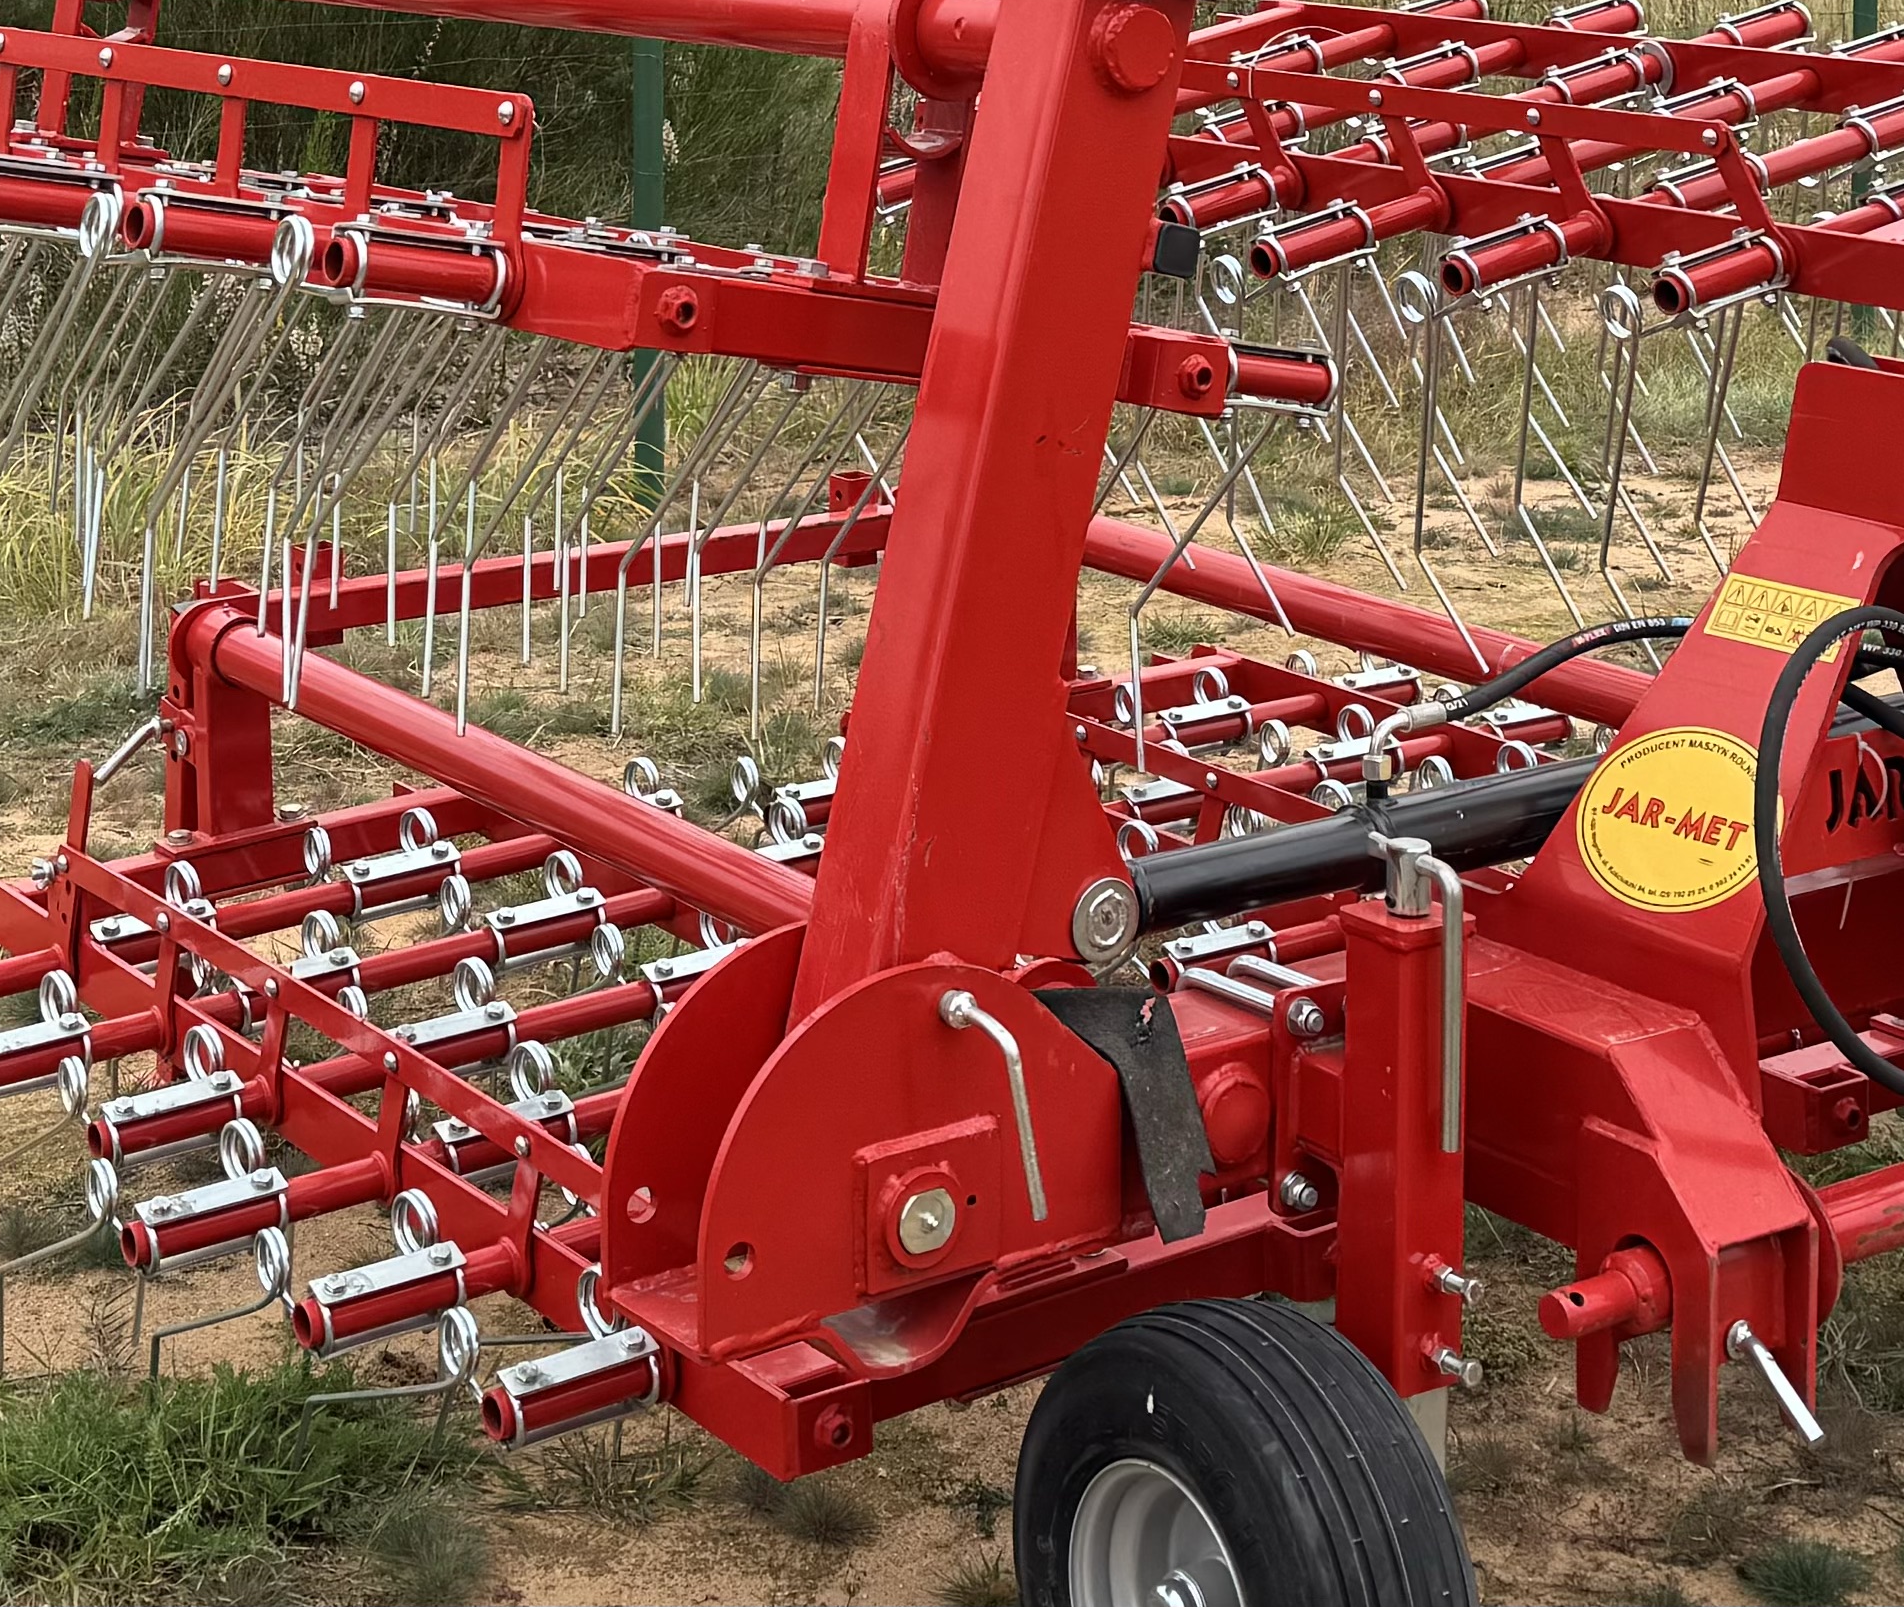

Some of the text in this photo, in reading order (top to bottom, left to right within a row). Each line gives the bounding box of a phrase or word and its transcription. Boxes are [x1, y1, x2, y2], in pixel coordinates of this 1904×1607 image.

[1619, 738, 1687, 770] PRODUCENT
[1687, 738, 1730, 758] MASZYN
[1601, 786, 1750, 852] JAR-MET
